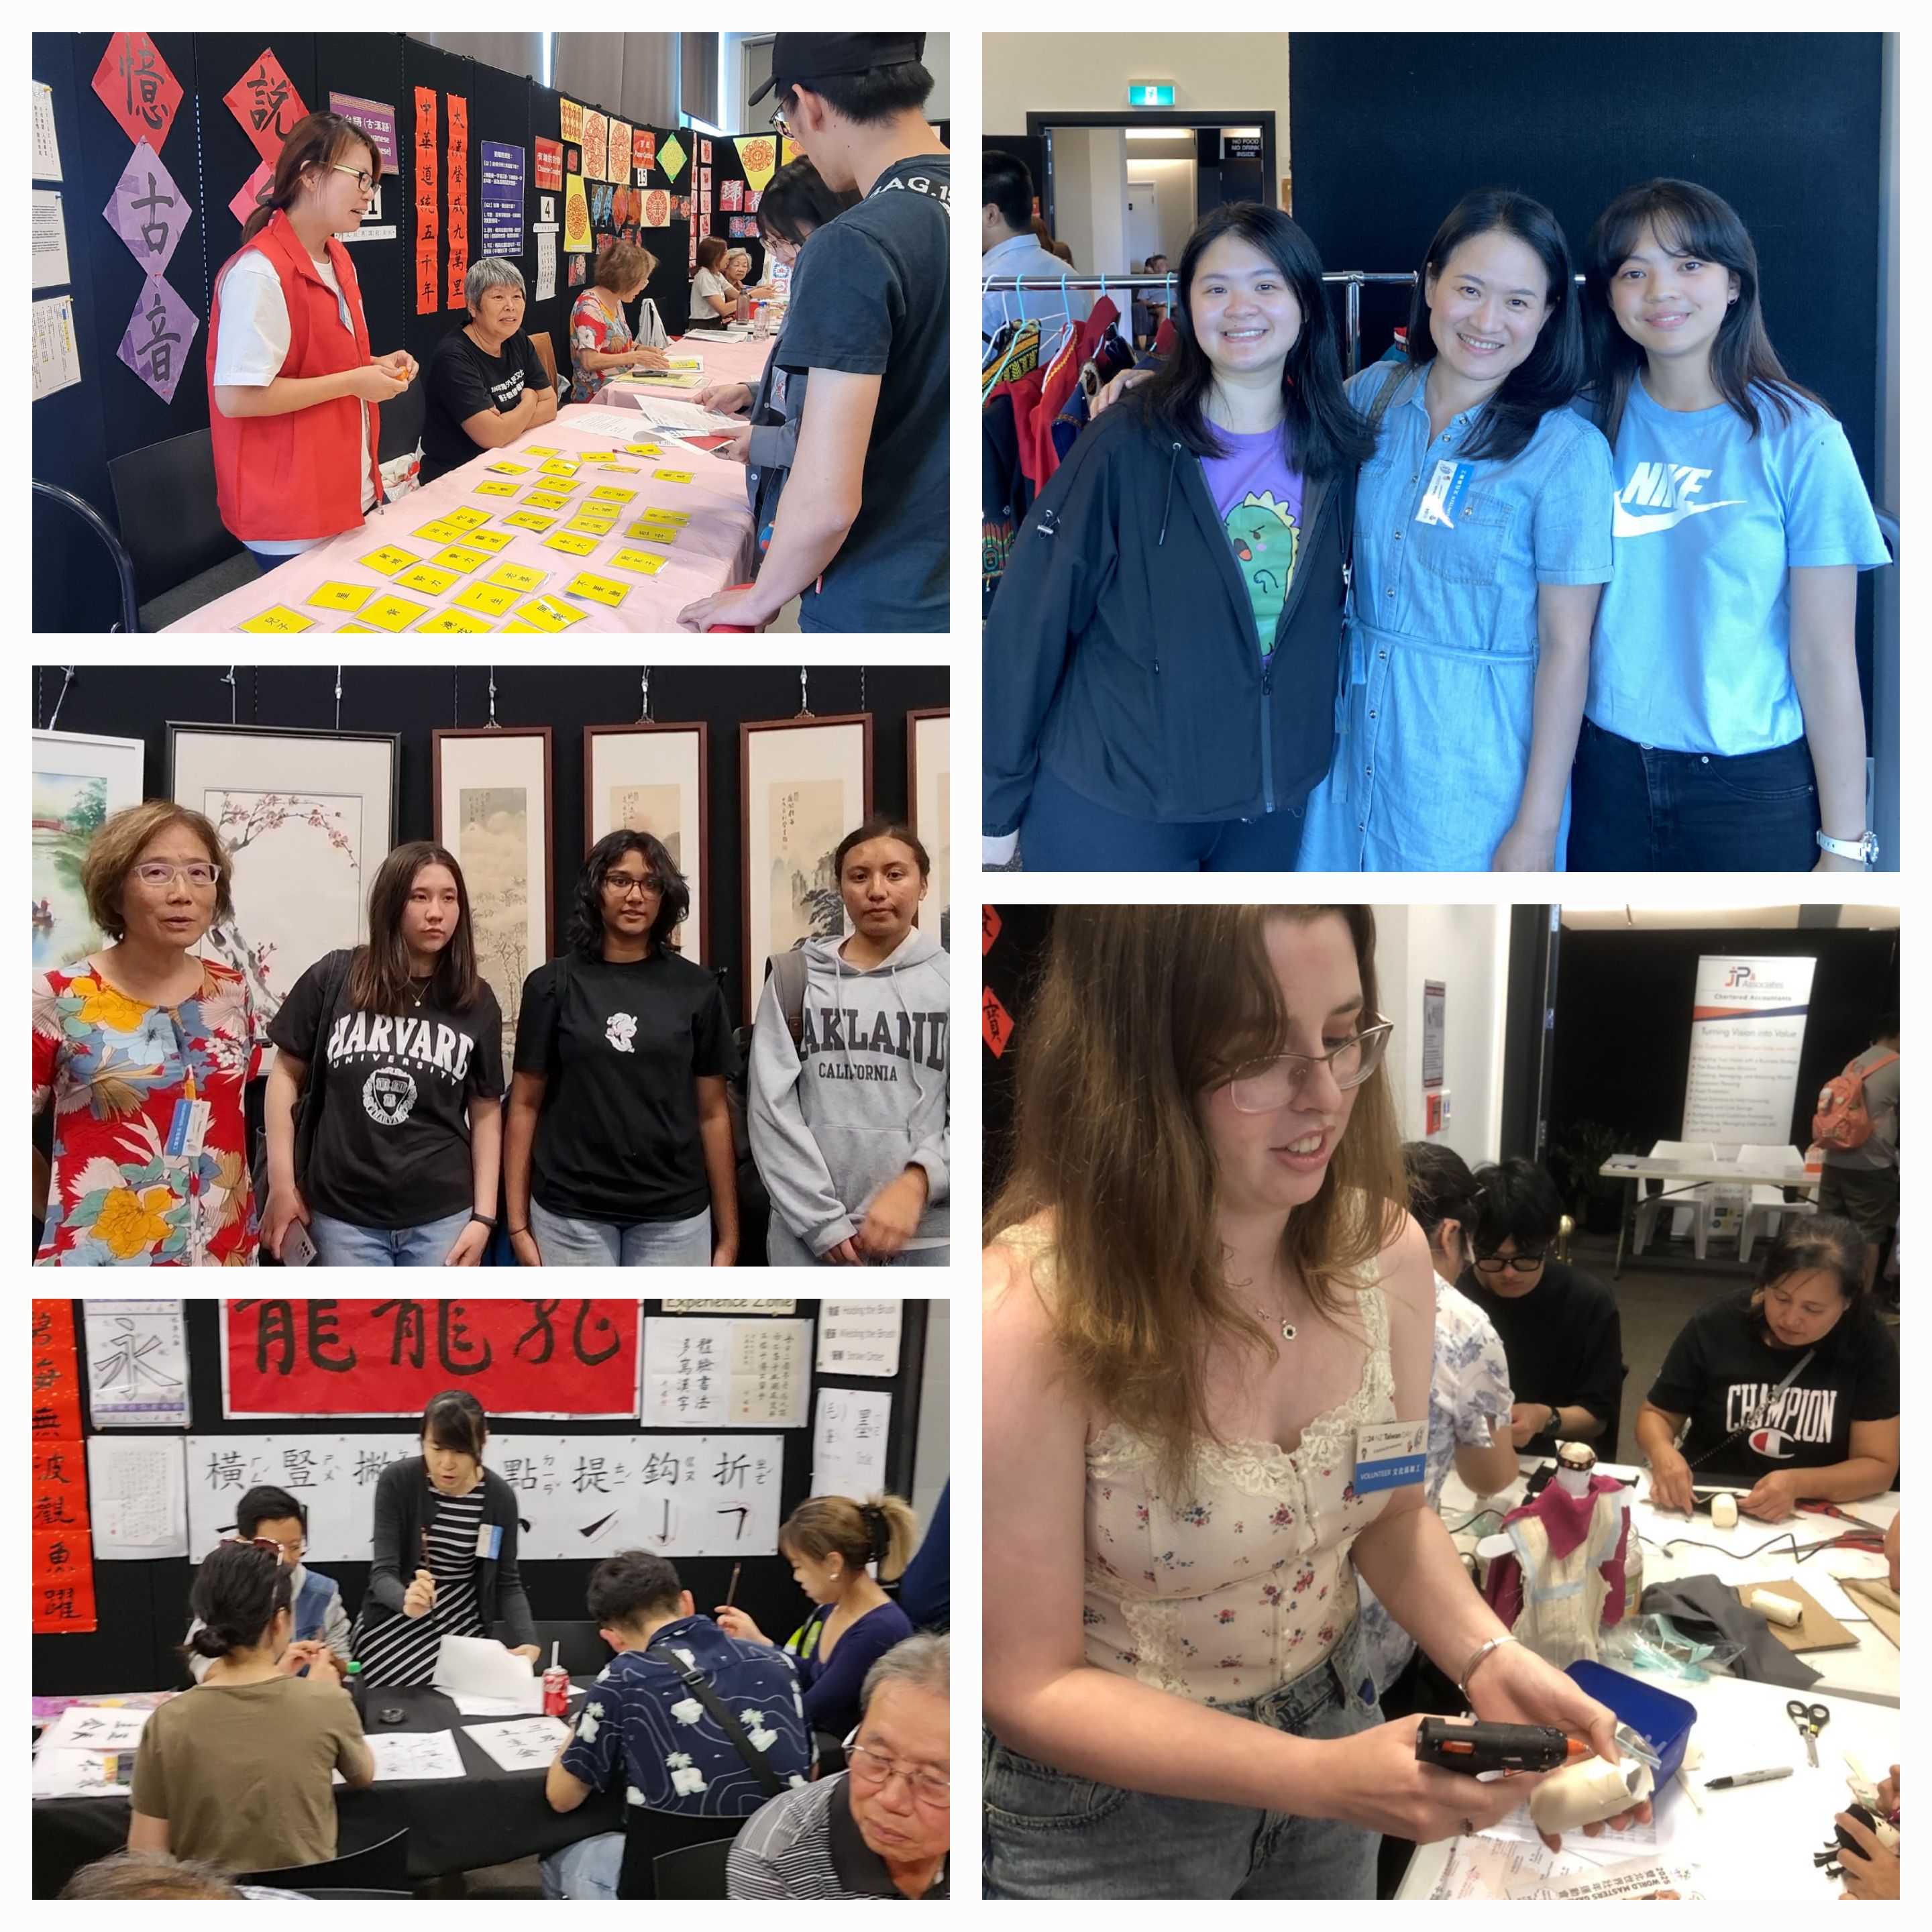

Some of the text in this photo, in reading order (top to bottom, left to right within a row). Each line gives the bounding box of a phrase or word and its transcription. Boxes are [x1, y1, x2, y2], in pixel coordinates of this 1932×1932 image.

[639, 170, 647, 184] 15
[131, 172, 174, 256] 古
[545, 200, 551, 219] 4
[136, 293, 181, 382] 音
[1621, 462, 1713, 508] NIKE
[1715, 993, 1792, 1002] Chartered Accountants
[1741, 979, 1784, 990] Associates
[327, 1010, 474, 1080] HARVARD
[799, 1008, 948, 1072] AKLAND
[1701, 1027, 1796, 1038] Turning Vision into Value
[93, 1317, 183, 1401] 永
[1726, 1383, 1837, 1443] CHAMPION
[205, 1450, 248, 1491] 橫
[282, 1448, 319, 1489] 豎
[503, 1456, 539, 1492] 點
[572, 1456, 612, 1495] 提
[712, 1451, 751, 1489] 折
[1360, 1468, 1391, 1481] VOLUNTEER
[1591, 1884, 1631, 1899] MASTERS
[1631, 1878, 1660, 1890] WORLD
